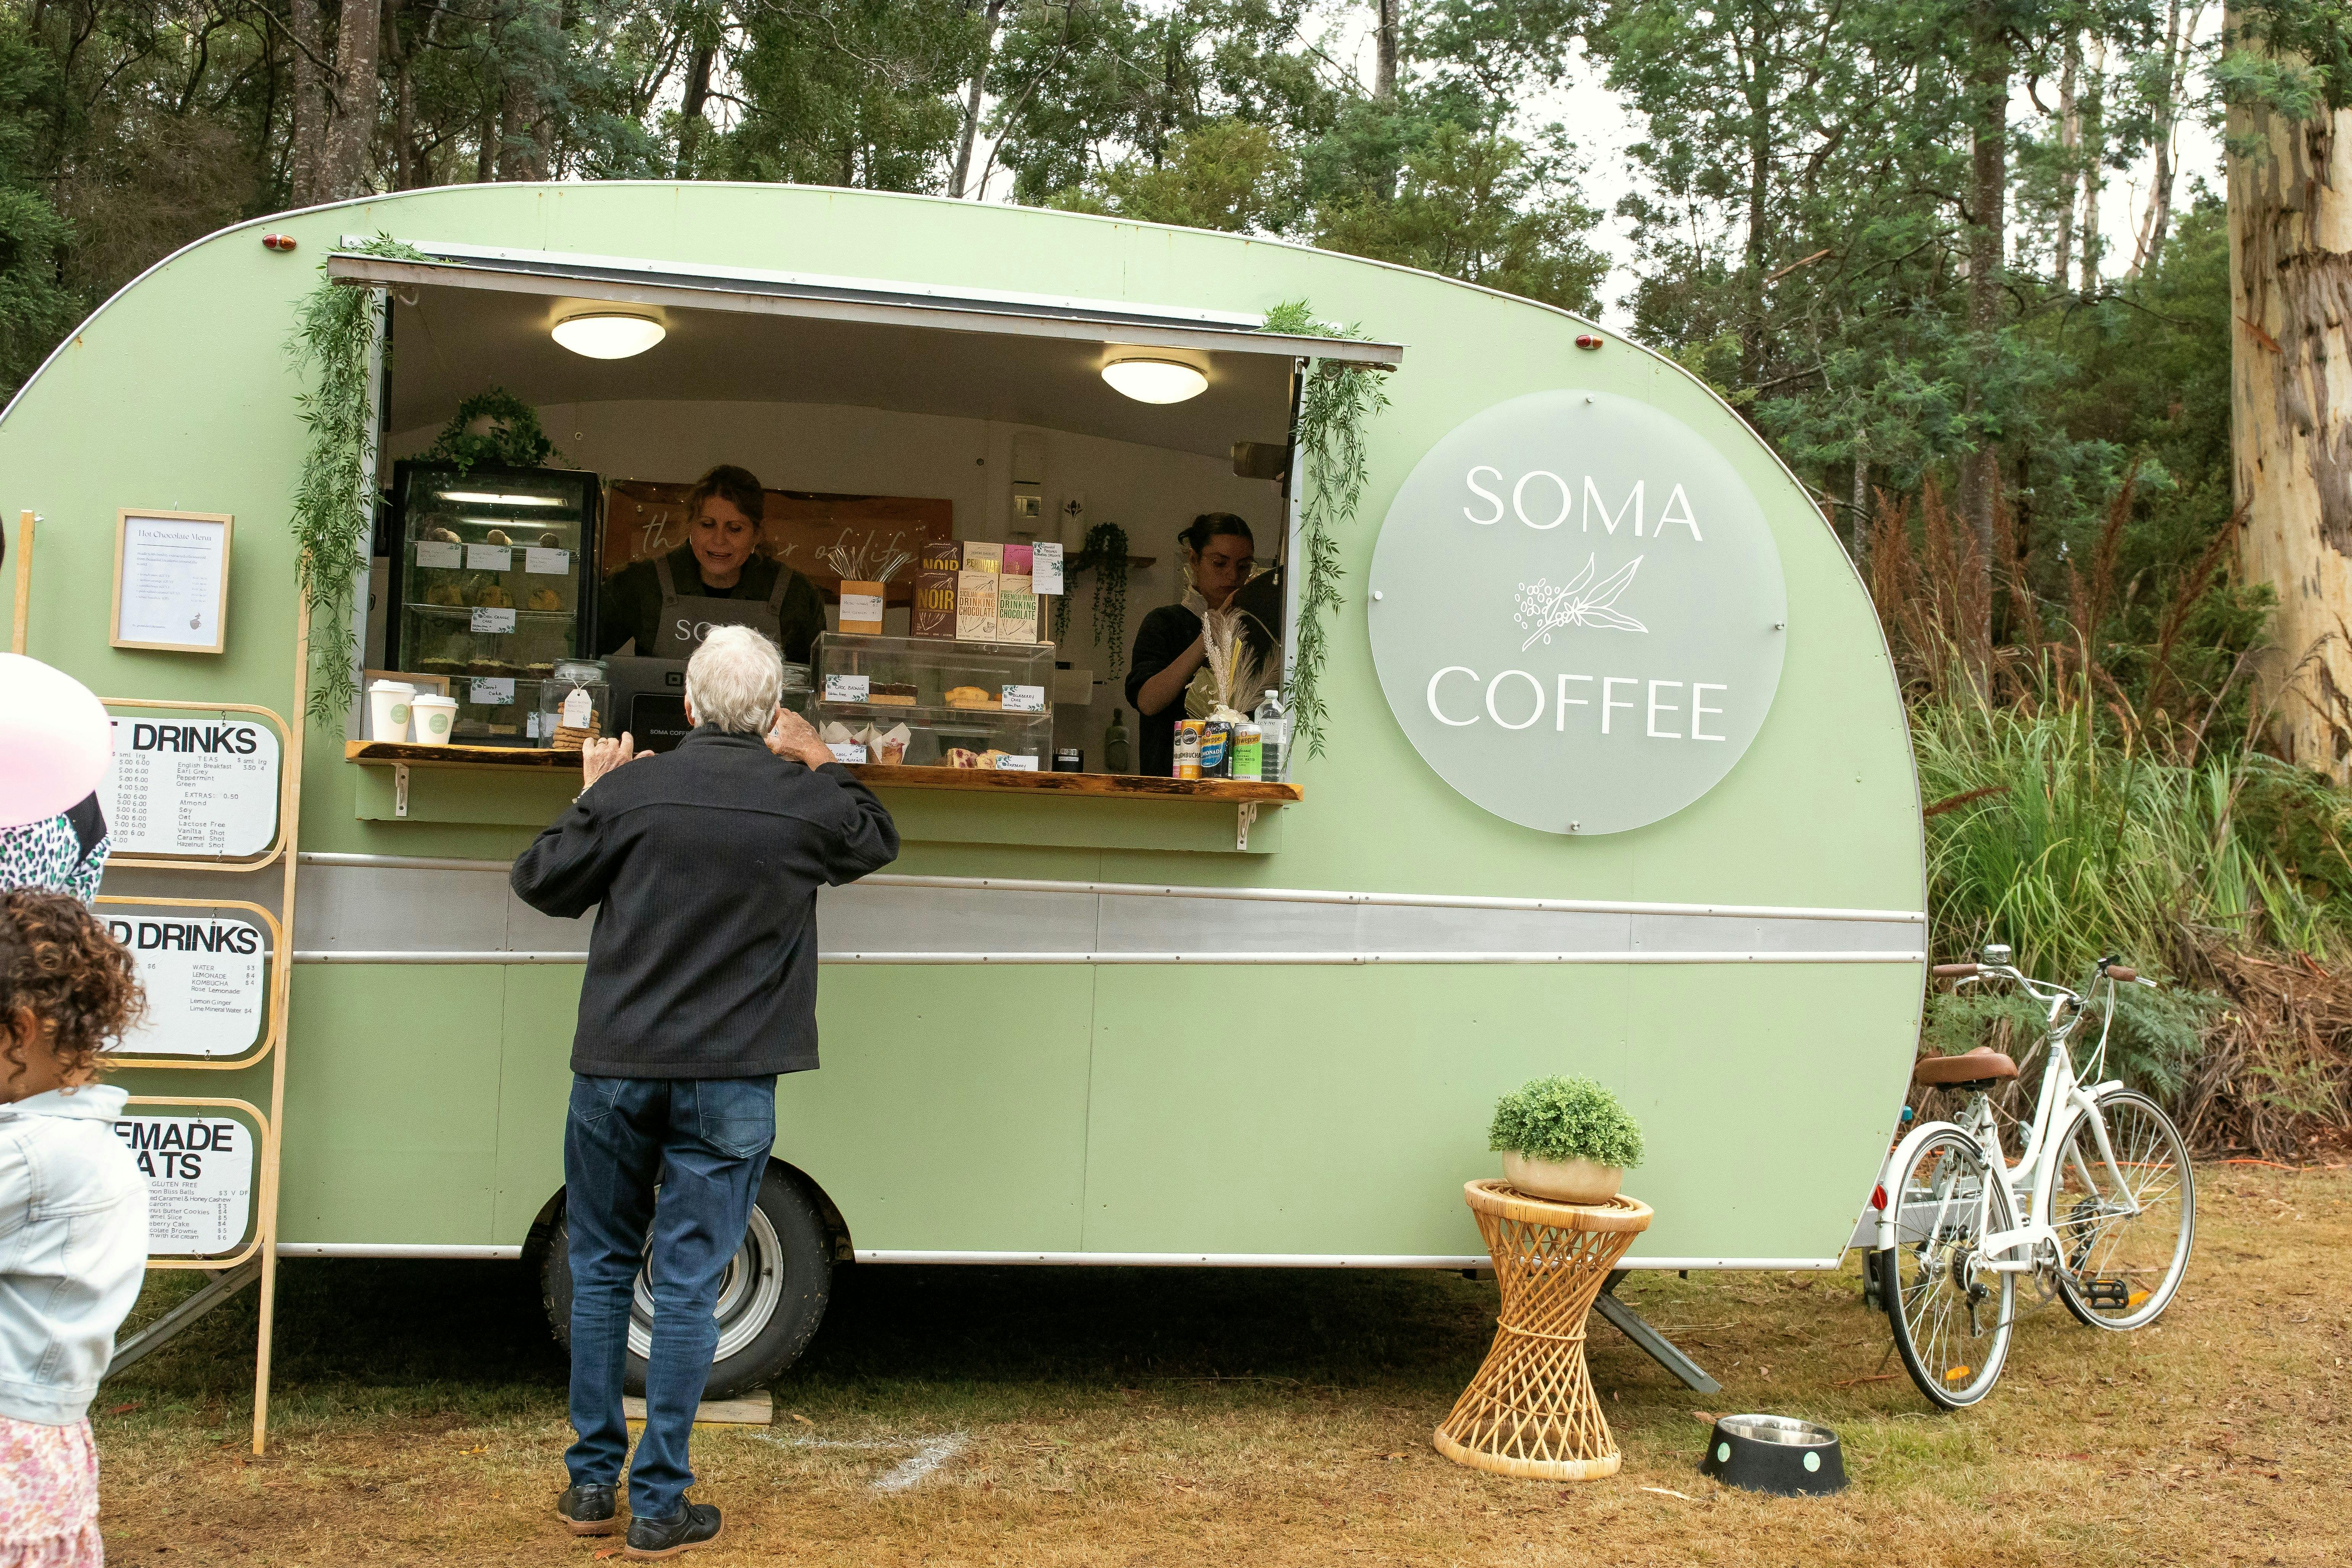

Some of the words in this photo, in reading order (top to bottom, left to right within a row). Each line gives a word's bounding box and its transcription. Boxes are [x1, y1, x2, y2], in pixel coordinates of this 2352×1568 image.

[1462, 465, 1704, 542] SOMA
[153, 531, 189, 539] Chocolate
[643, 511, 683, 553] th
[917, 589, 954, 610] NOIR
[959, 597, 995, 608] DRINKING
[959, 606, 995, 618] CHOCOLATE
[1000, 600, 1036, 611] DRINKING
[1000, 608, 1035, 620] CHOCOLATE
[1426, 666, 1728, 741] COFFEE
[133, 724, 256, 754] DRINKS
[1202, 736, 1223, 744] hweppes
[138, 922, 259, 955] DRINKS
[115, 1121, 234, 1152] EMADE
[137, 1150, 201, 1179] ATS
